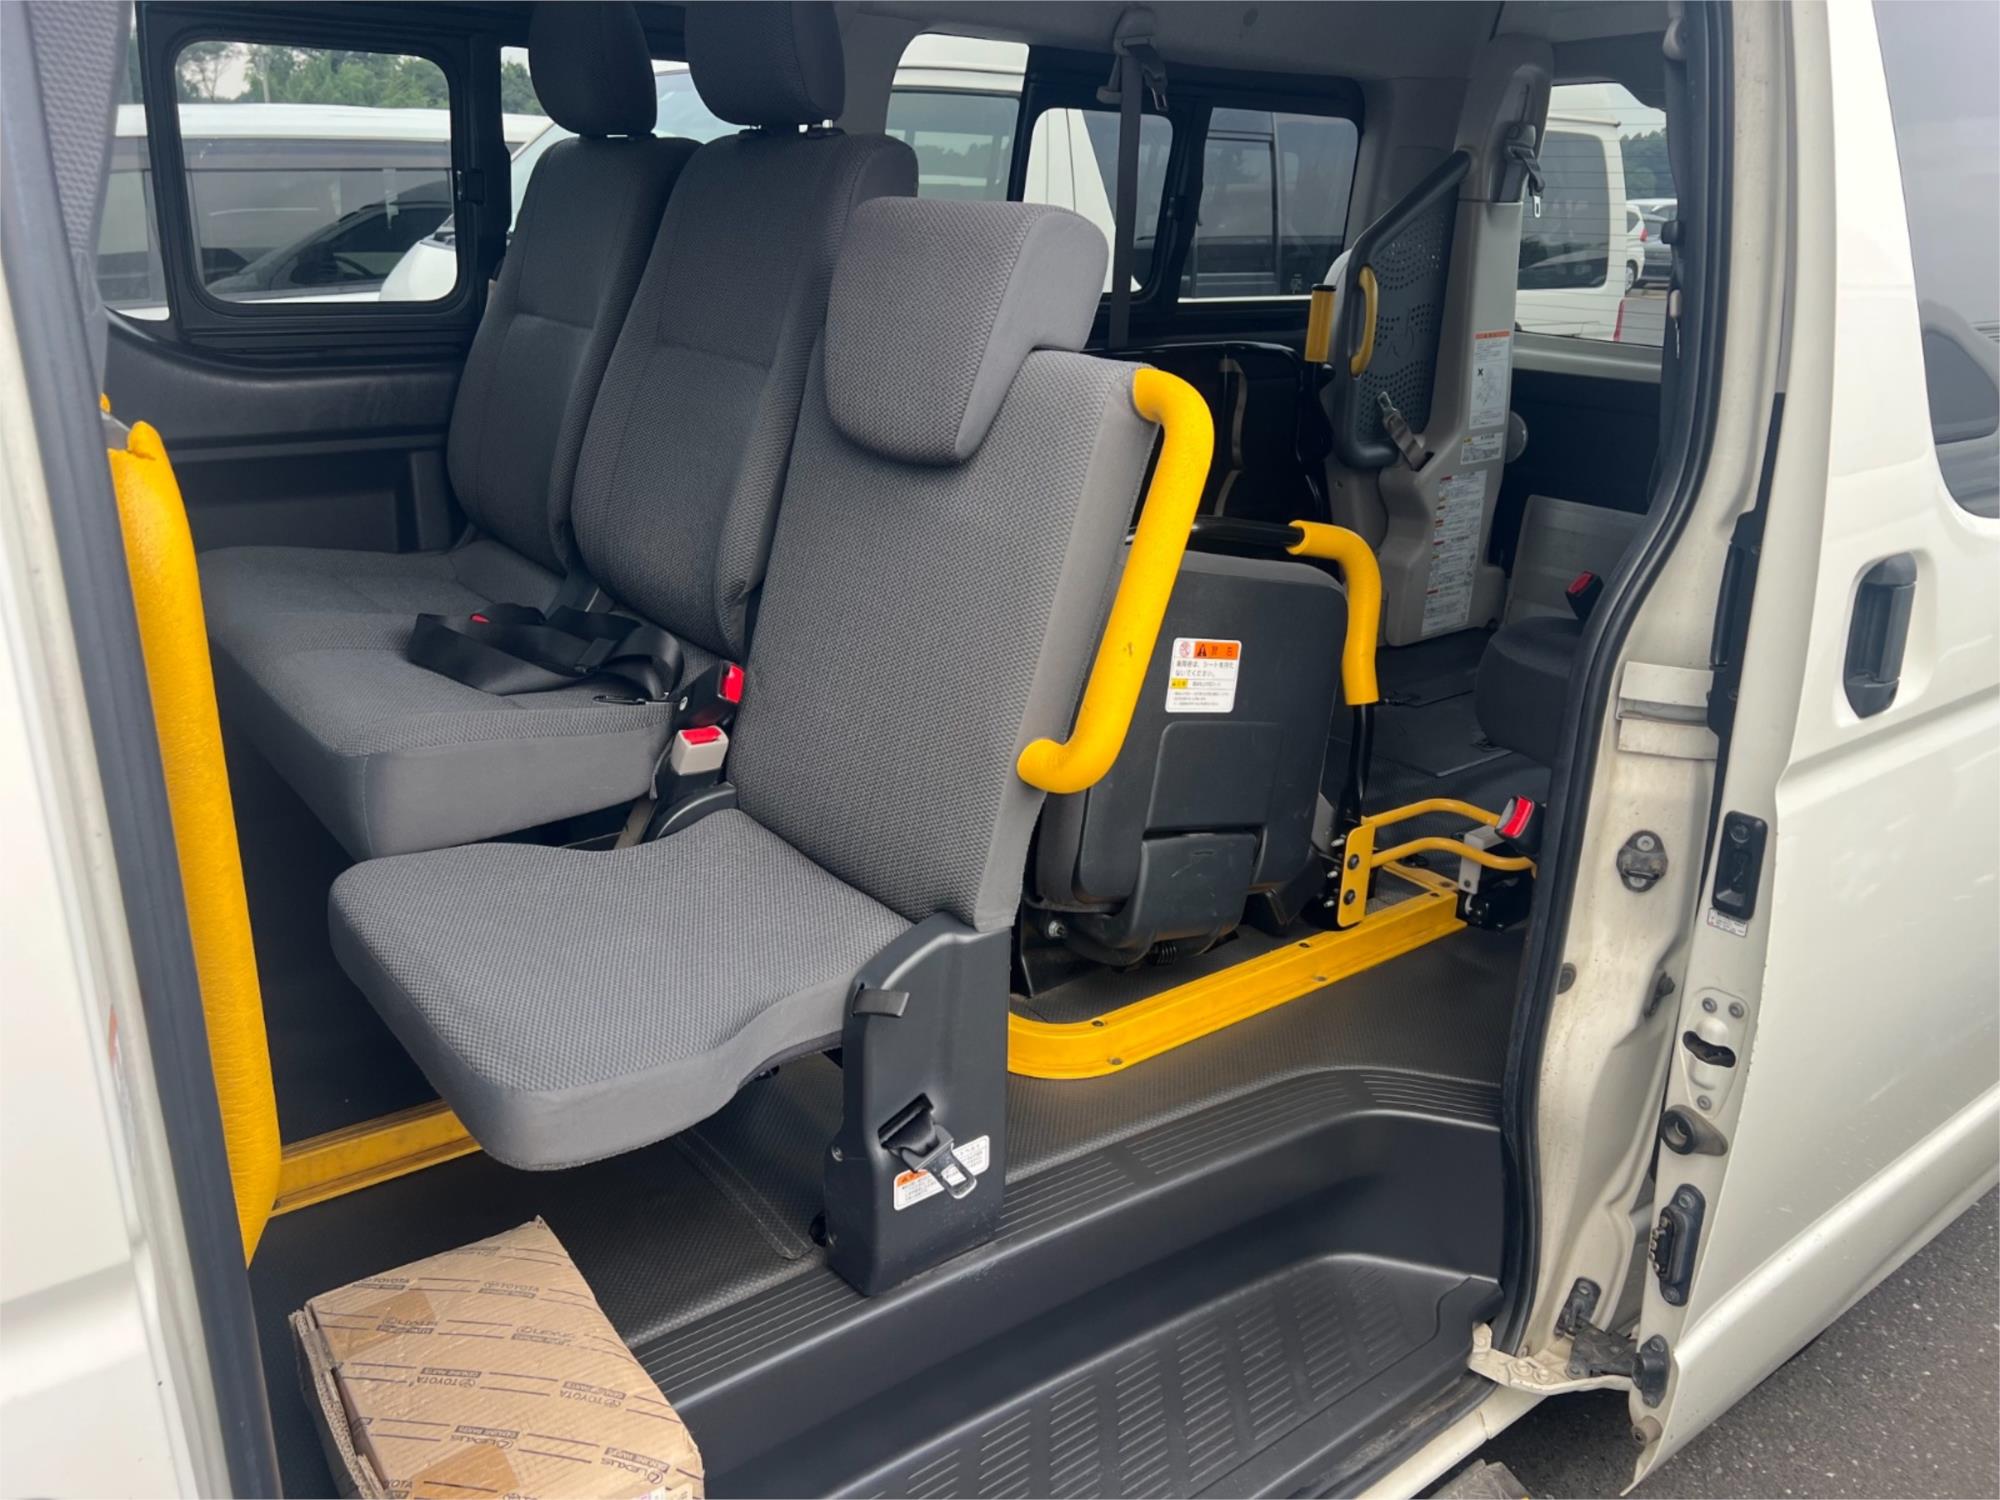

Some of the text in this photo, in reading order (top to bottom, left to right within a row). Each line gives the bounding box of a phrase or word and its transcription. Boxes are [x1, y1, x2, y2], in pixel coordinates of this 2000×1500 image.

[416, 1376, 457, 1386] TOYOTA
[559, 1390, 602, 1404] TOYOTA
[601, 1457, 647, 1476] LEXUS
